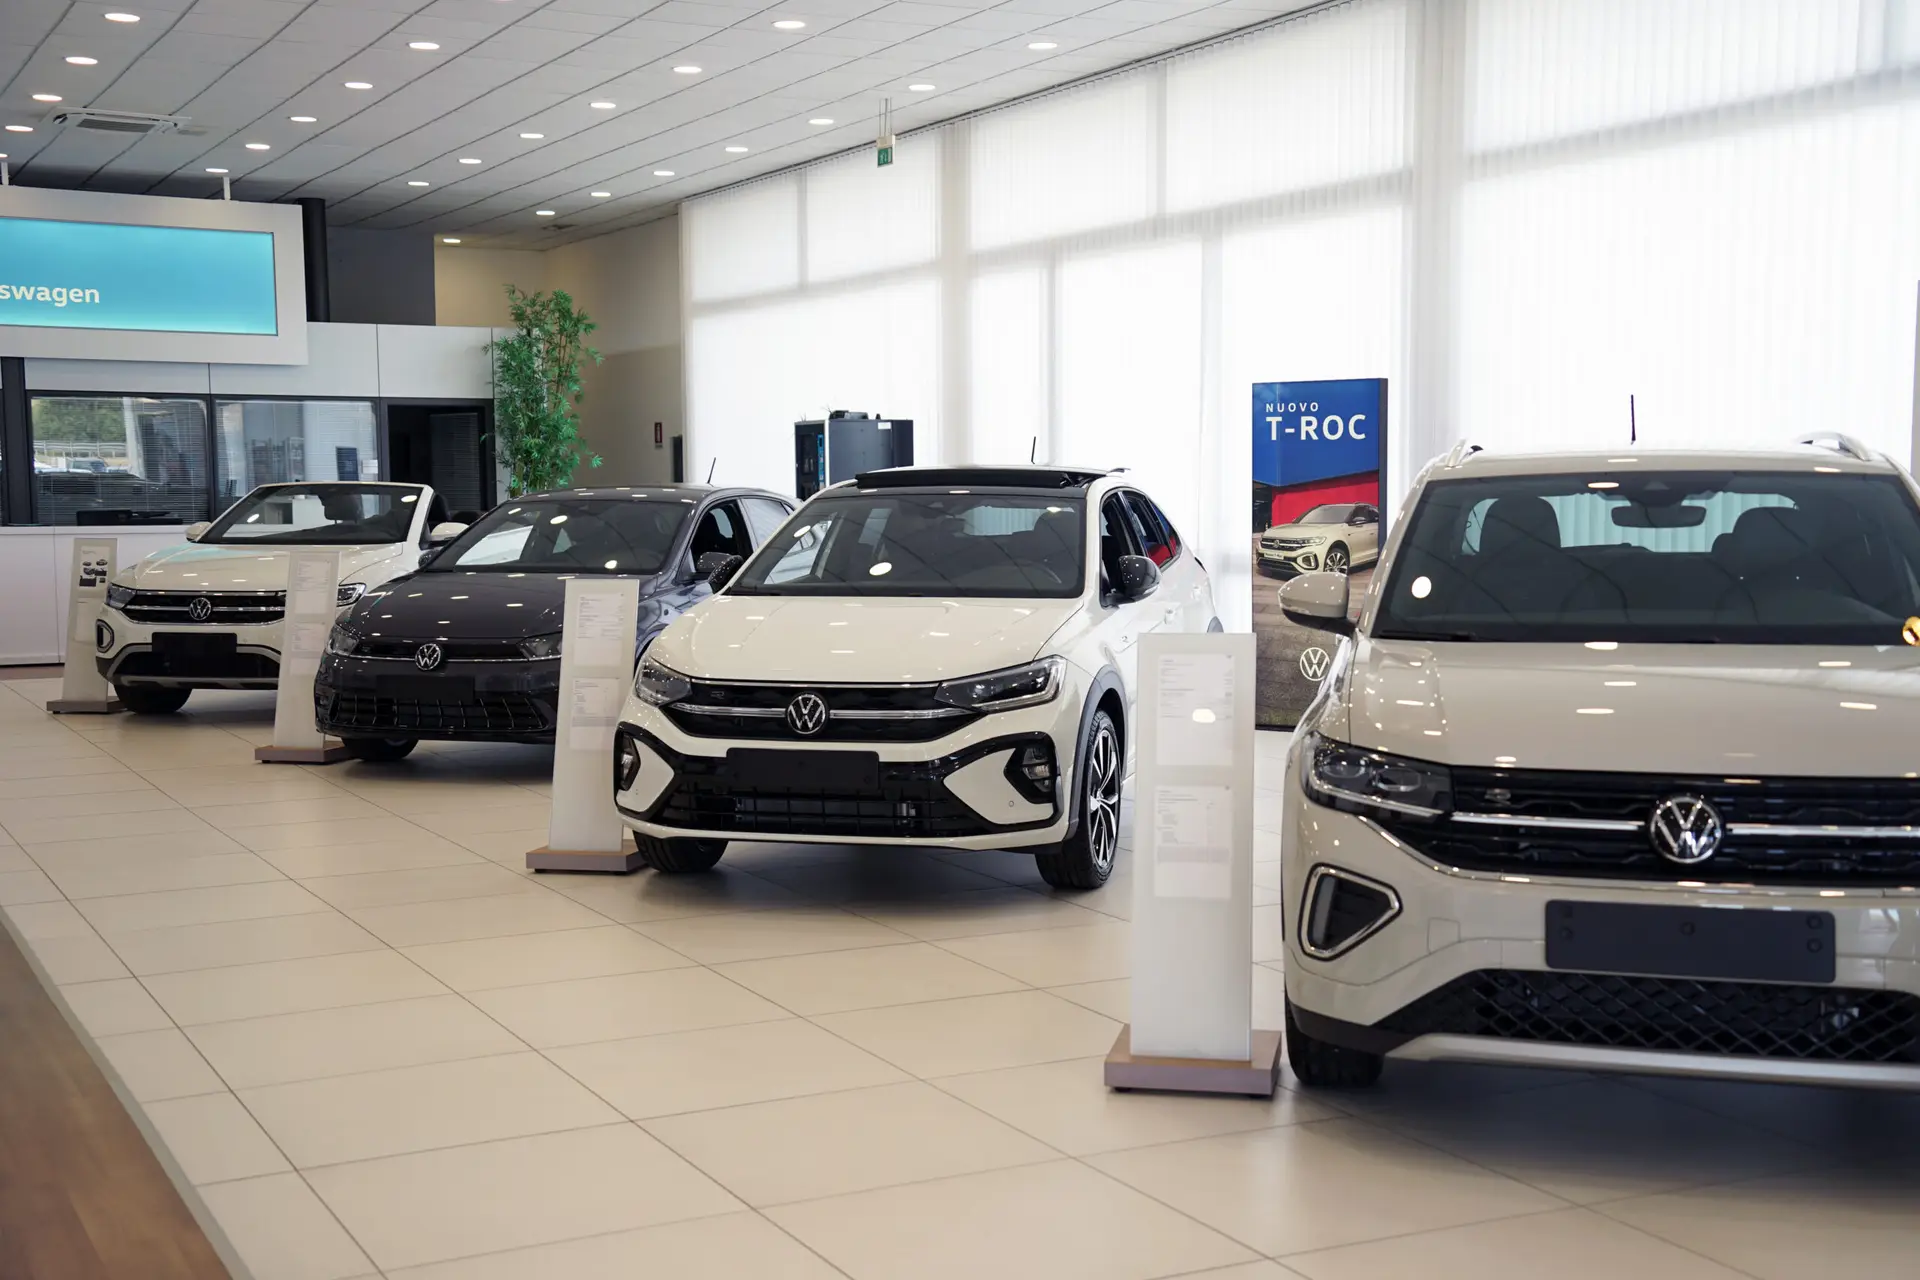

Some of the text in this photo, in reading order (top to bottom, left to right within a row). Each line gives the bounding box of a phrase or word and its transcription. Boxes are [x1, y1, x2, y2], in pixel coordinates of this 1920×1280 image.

[0, 284, 100, 307] swagen
[1265, 402, 1319, 413] NUOVO
[1265, 414, 1366, 440] T-ROC
[1299, 647, 1330, 681] VW
[787, 694, 826, 735] VW
[1650, 796, 1721, 864] VW
